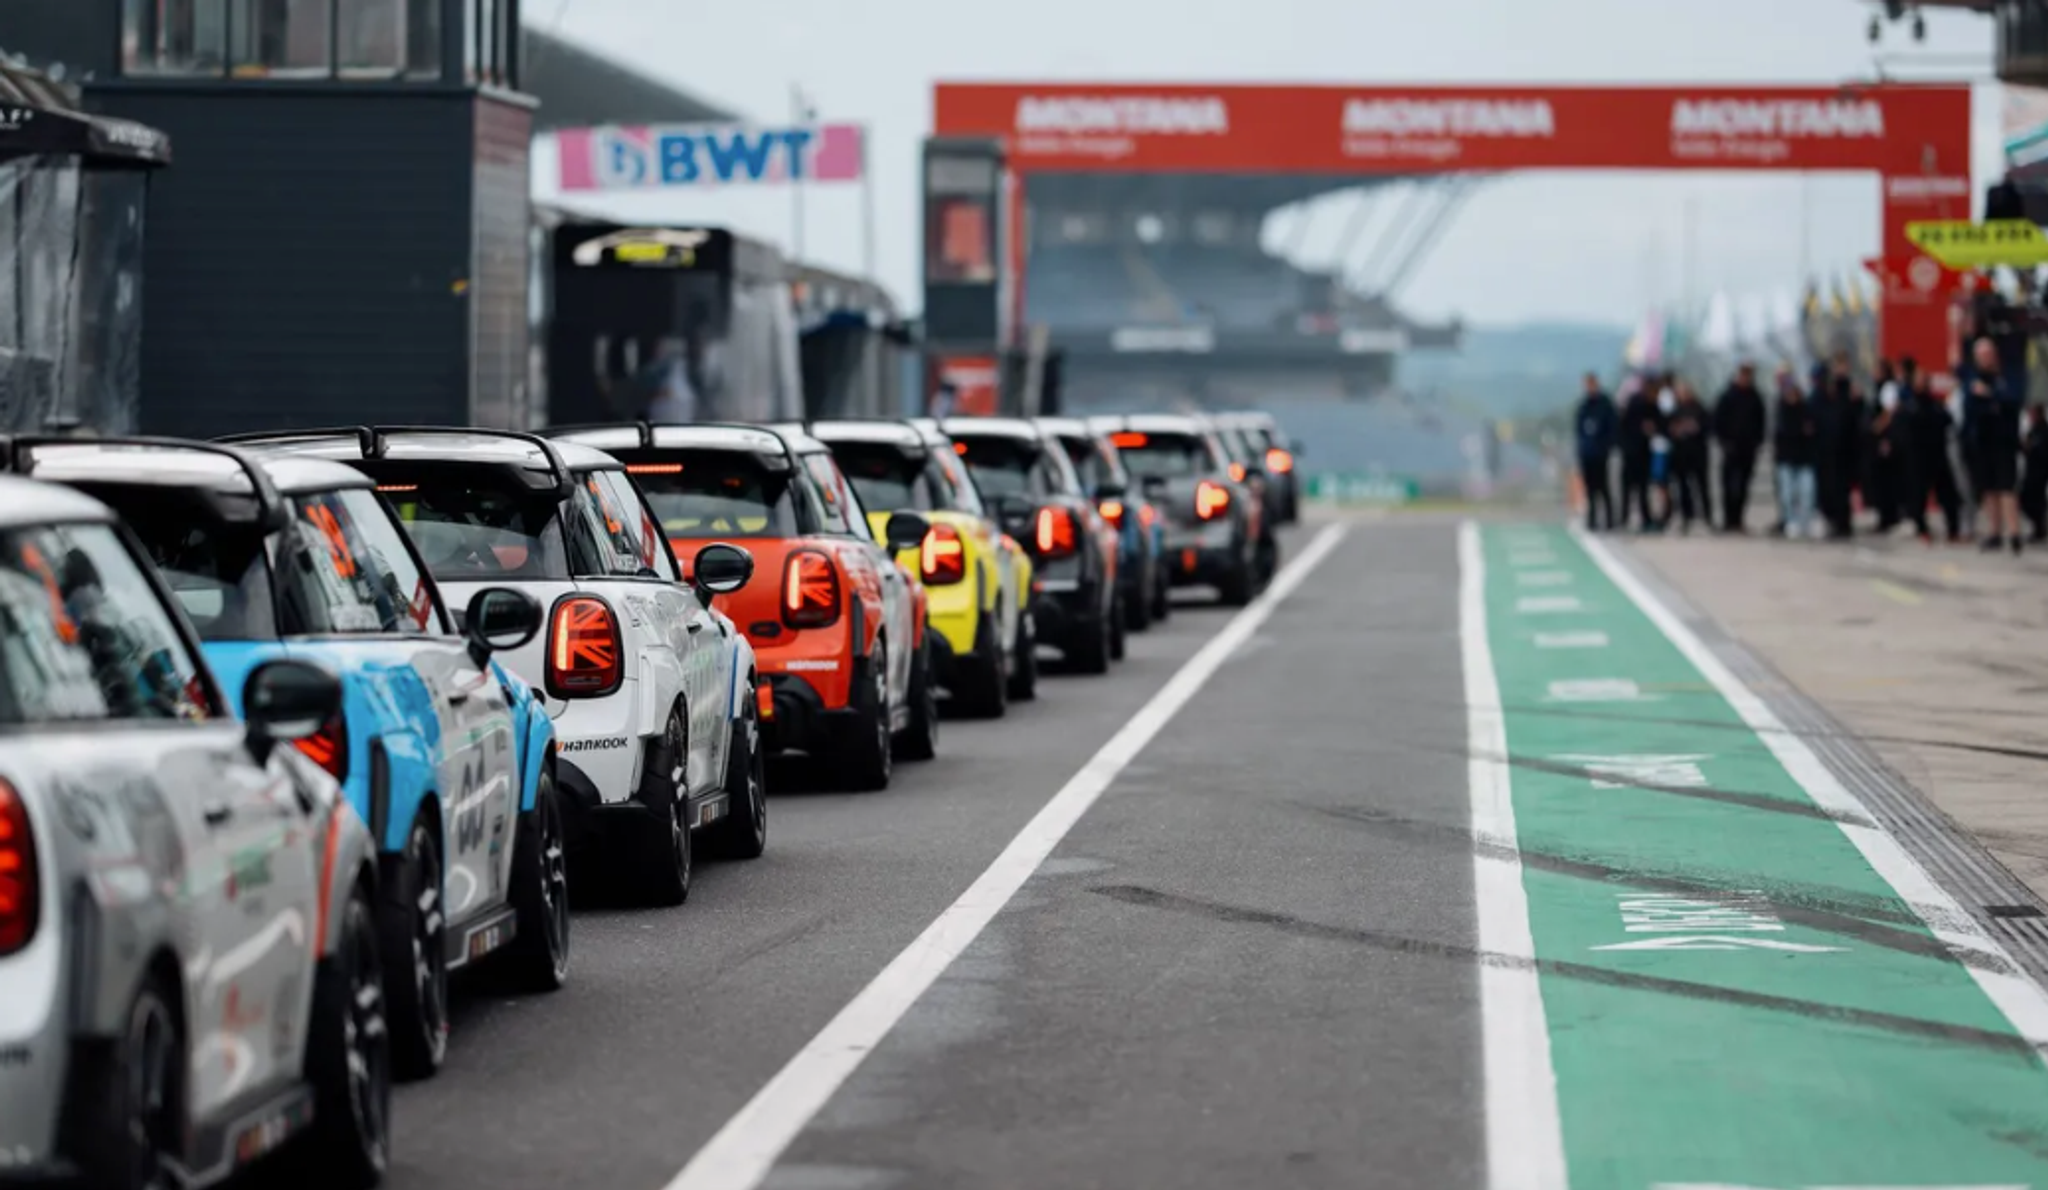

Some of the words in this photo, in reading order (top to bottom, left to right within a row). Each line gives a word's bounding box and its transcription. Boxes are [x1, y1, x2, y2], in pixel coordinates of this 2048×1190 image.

[1016, 96, 1228, 135] MONTANA
[1341, 98, 1555, 137] MONTANA
[1671, 98, 1885, 138] MONTANA
[660, 131, 809, 182] BWT
